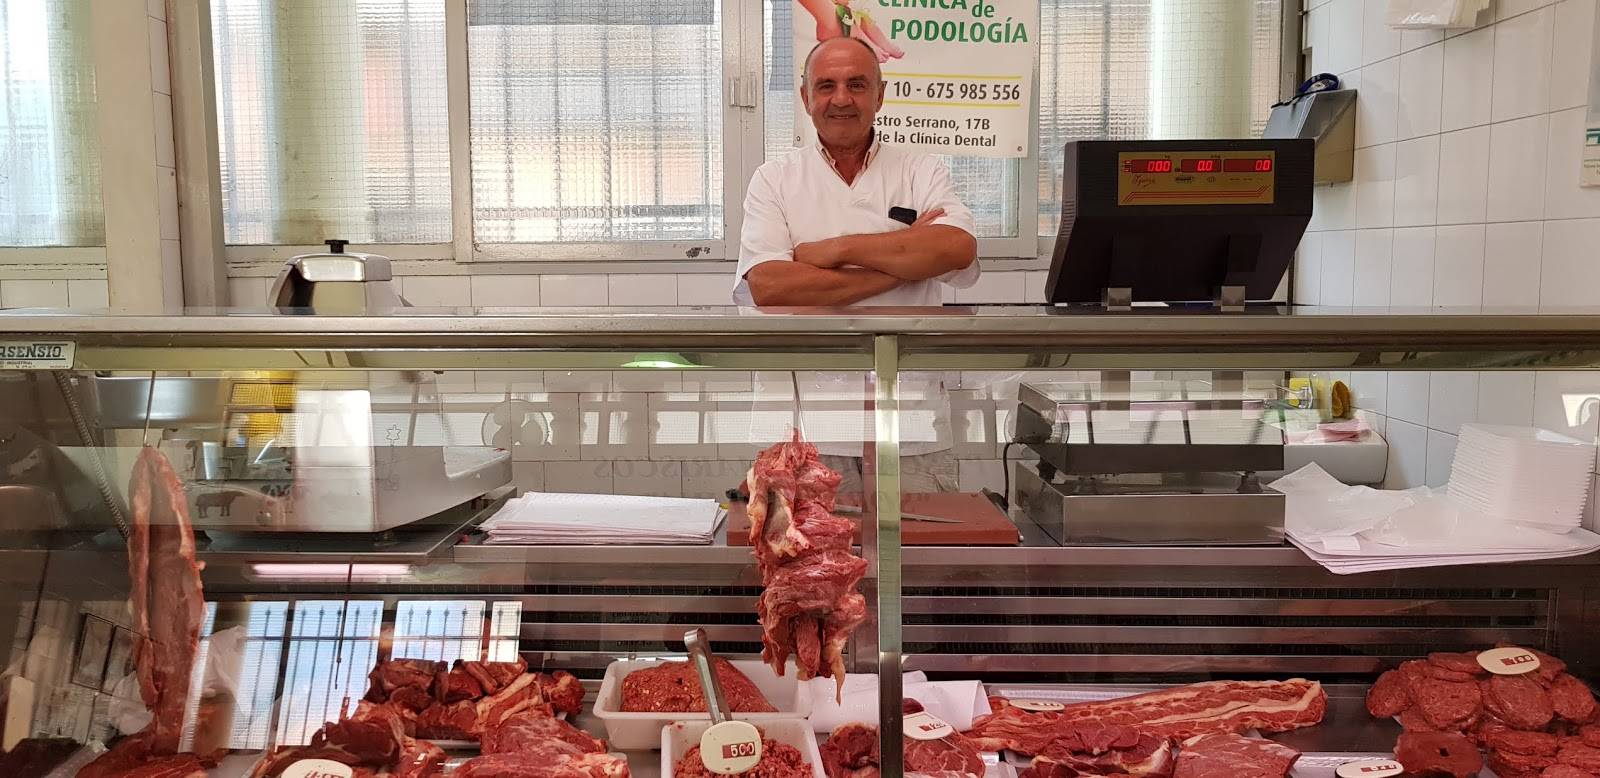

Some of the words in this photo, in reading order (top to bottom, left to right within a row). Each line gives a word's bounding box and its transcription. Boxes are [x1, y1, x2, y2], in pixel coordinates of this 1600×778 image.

[890, 17, 1028, 43] PODOLOGÍA
[893, 81, 911, 97] 10
[926, 82, 954, 99] 675
[959, 83, 987, 100] 985
[992, 84, 1020, 100] 556
[873, 115, 901, 127] stro
[905, 115, 960, 131] Serrano,
[965, 118, 990, 130] 17B
[894, 131, 905, 144] la
[910, 132, 950, 145] Clínica
[954, 135, 996, 146] Dental
